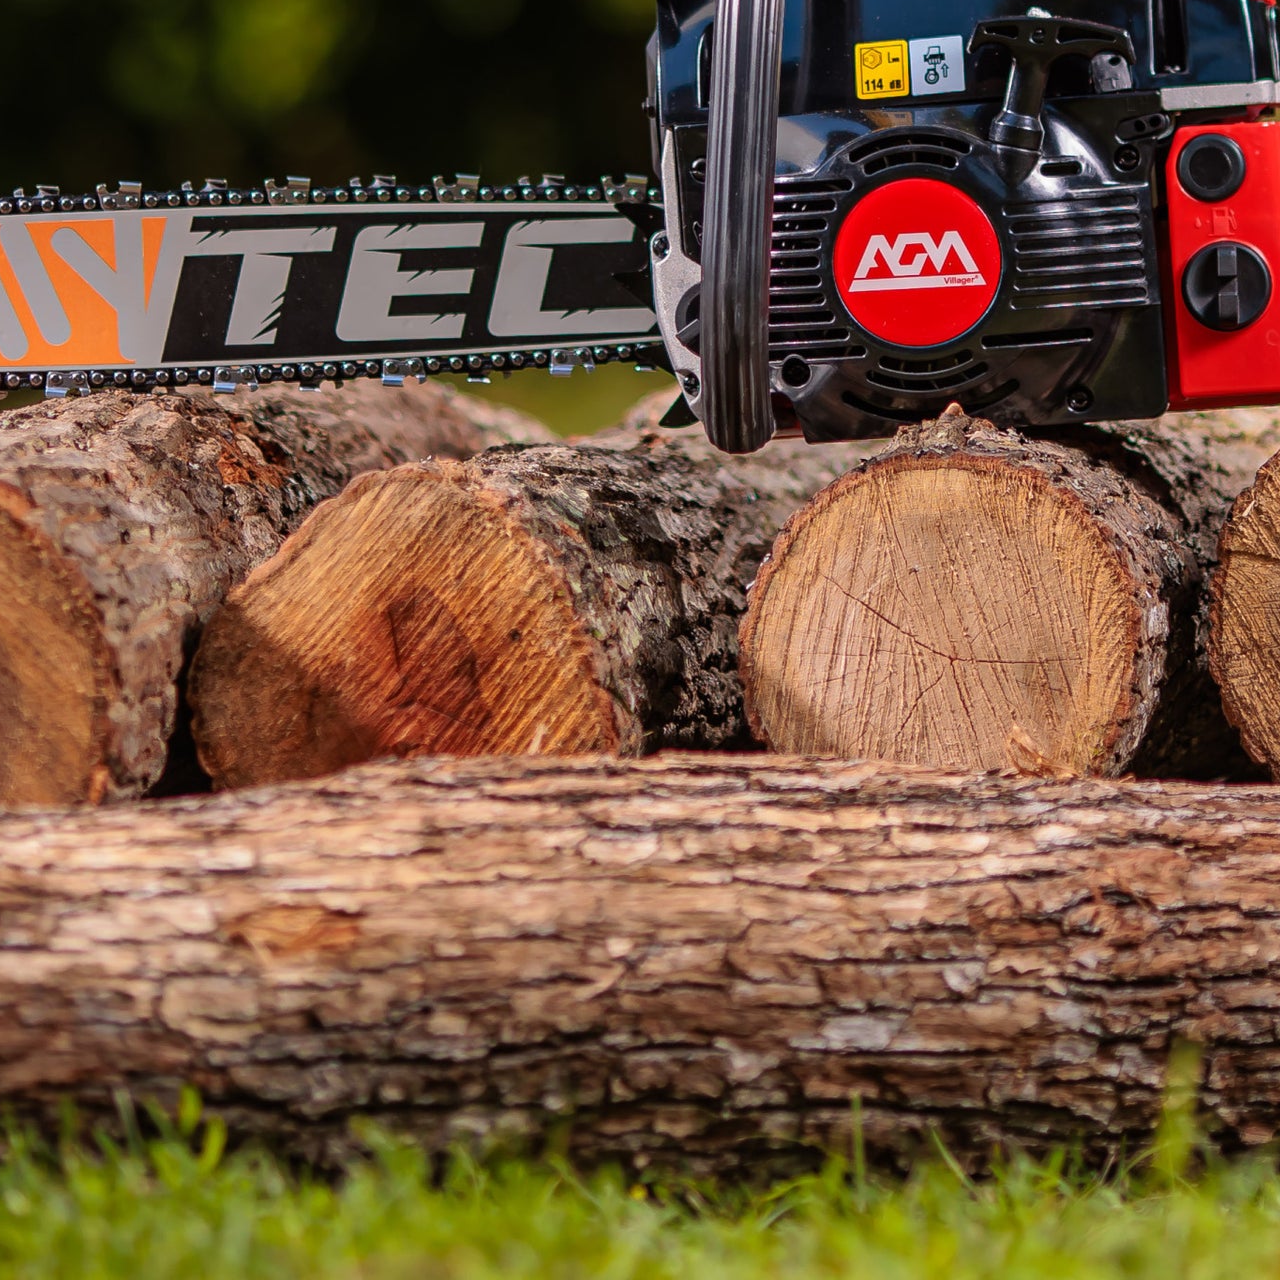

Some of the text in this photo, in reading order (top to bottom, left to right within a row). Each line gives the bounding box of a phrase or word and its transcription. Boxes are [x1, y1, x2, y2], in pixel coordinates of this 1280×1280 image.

[865, 78, 902, 92] 114 dB
[853, 230, 980, 279] AGM
